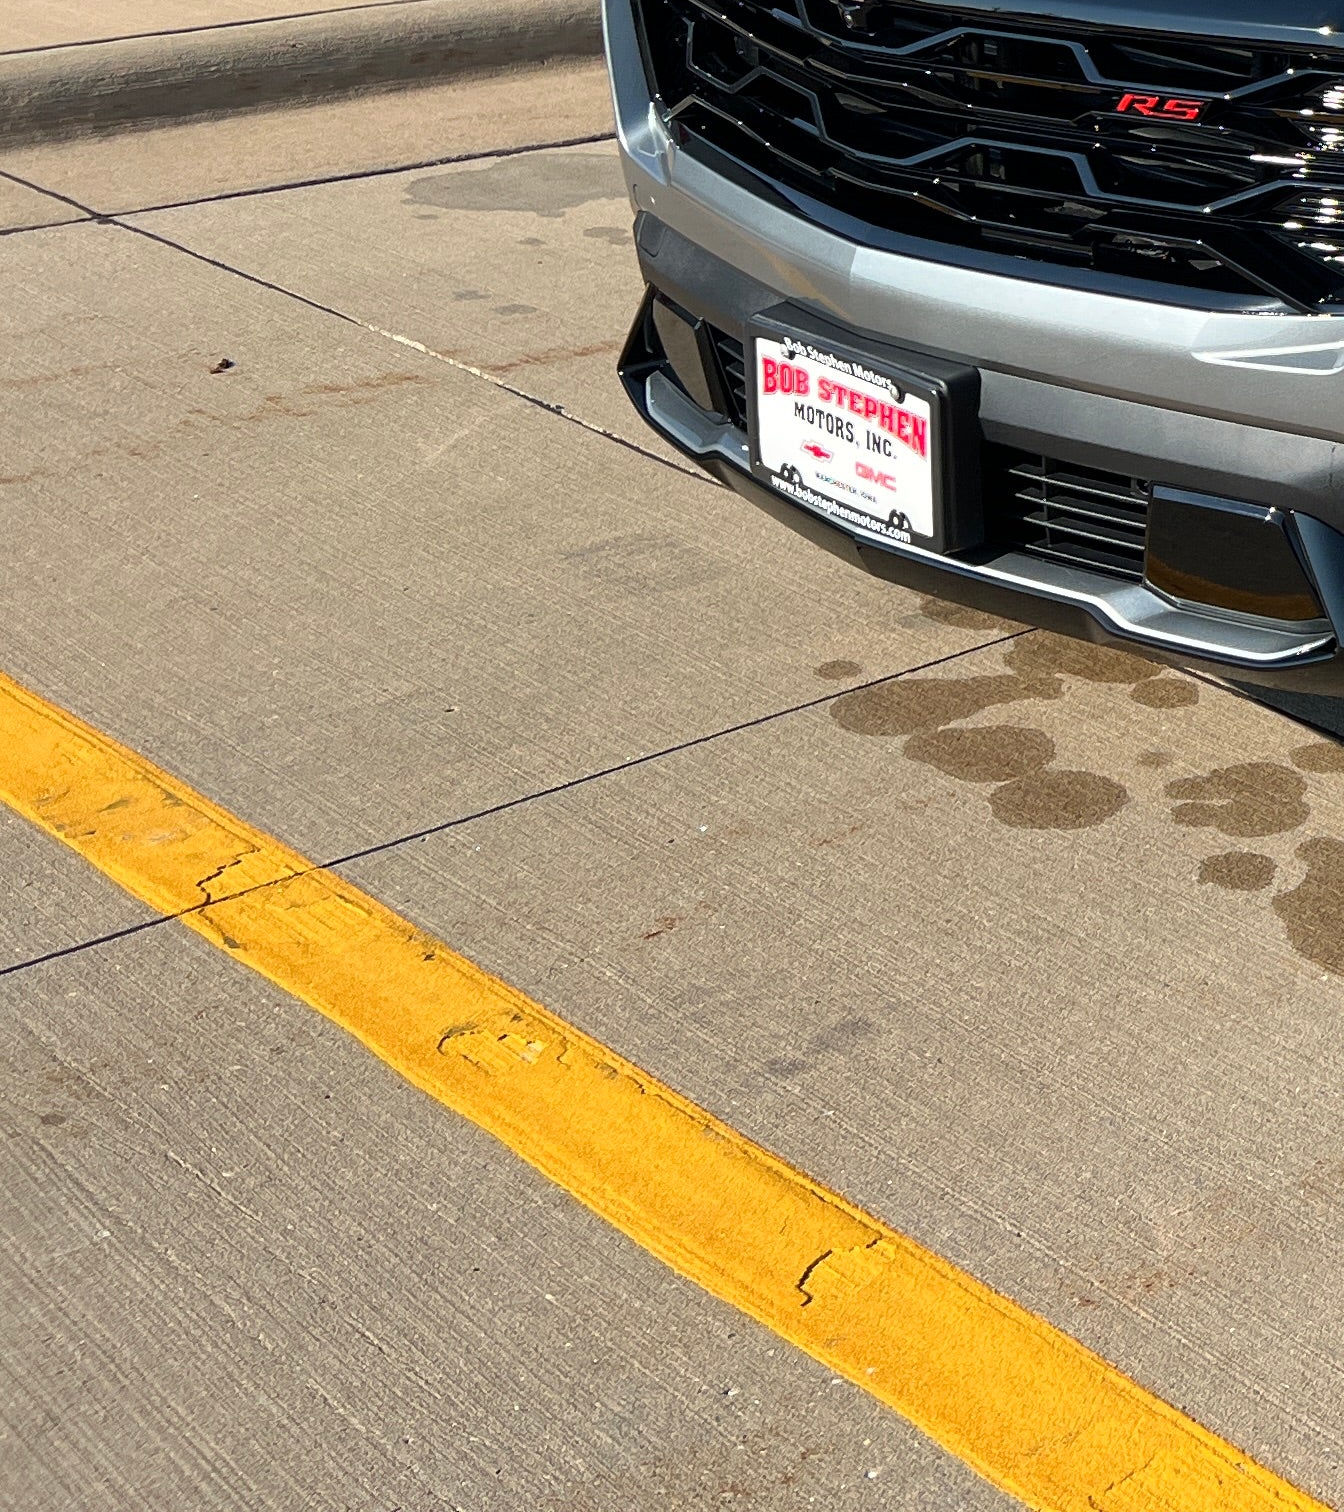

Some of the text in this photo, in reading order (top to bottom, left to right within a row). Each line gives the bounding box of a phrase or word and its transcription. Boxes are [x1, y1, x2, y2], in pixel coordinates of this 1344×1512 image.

[1115, 92, 1205, 121] RS
[783, 336, 893, 390] Bob Stephen Motors
[761, 354, 928, 463] BOB STEPHEN
[865, 429, 898, 460] INC.
[769, 473, 912, 544] www.bobstephenmotors.com
